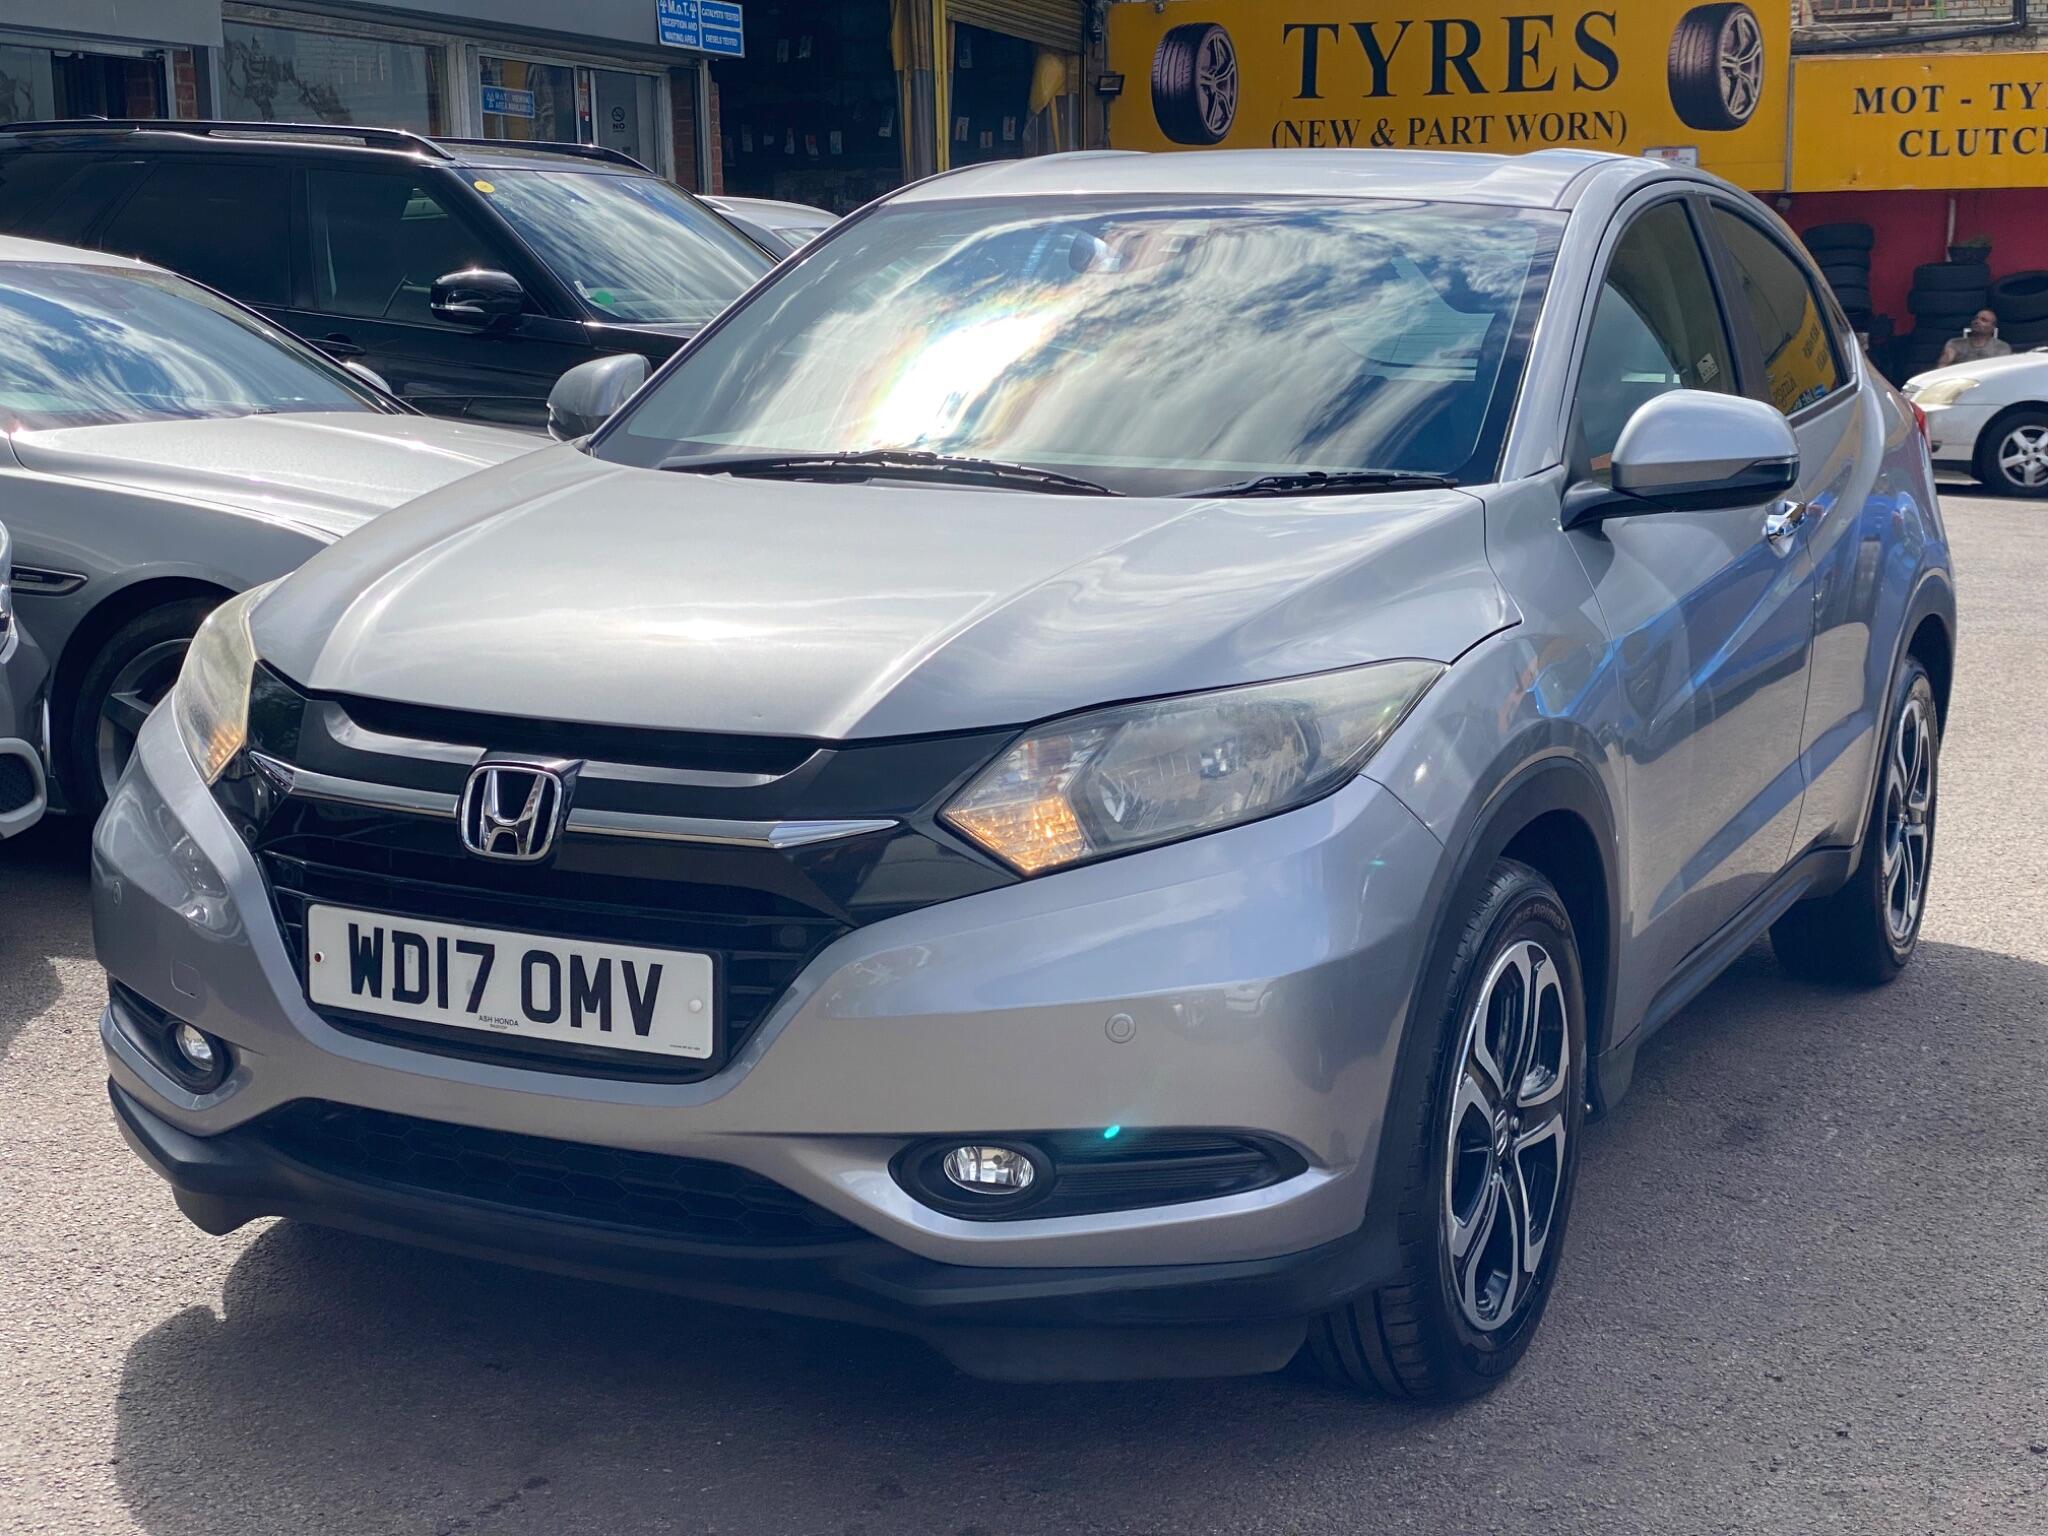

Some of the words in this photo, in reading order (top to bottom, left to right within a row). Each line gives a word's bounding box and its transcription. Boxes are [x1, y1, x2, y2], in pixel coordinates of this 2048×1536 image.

[661, 17, 688, 29] RECEPTION
[687, 21, 698, 31] AND
[684, 35, 697, 44] AREA
[1283, 10, 1620, 99] TYRES
[1852, 85, 1945, 115] MOT
[1989, 82, 2048, 111] TY
[1271, 118, 1361, 148] (NEW
[1370, 117, 1397, 147] &
[1407, 115, 1496, 146] PART
[1504, 110, 1628, 147] WORN)
[1898, 127, 2048, 158] CLUTC
[348, 922, 495, 1014] WD17
[520, 949, 664, 1037] OMV
[494, 1017, 519, 1026] HONDA
